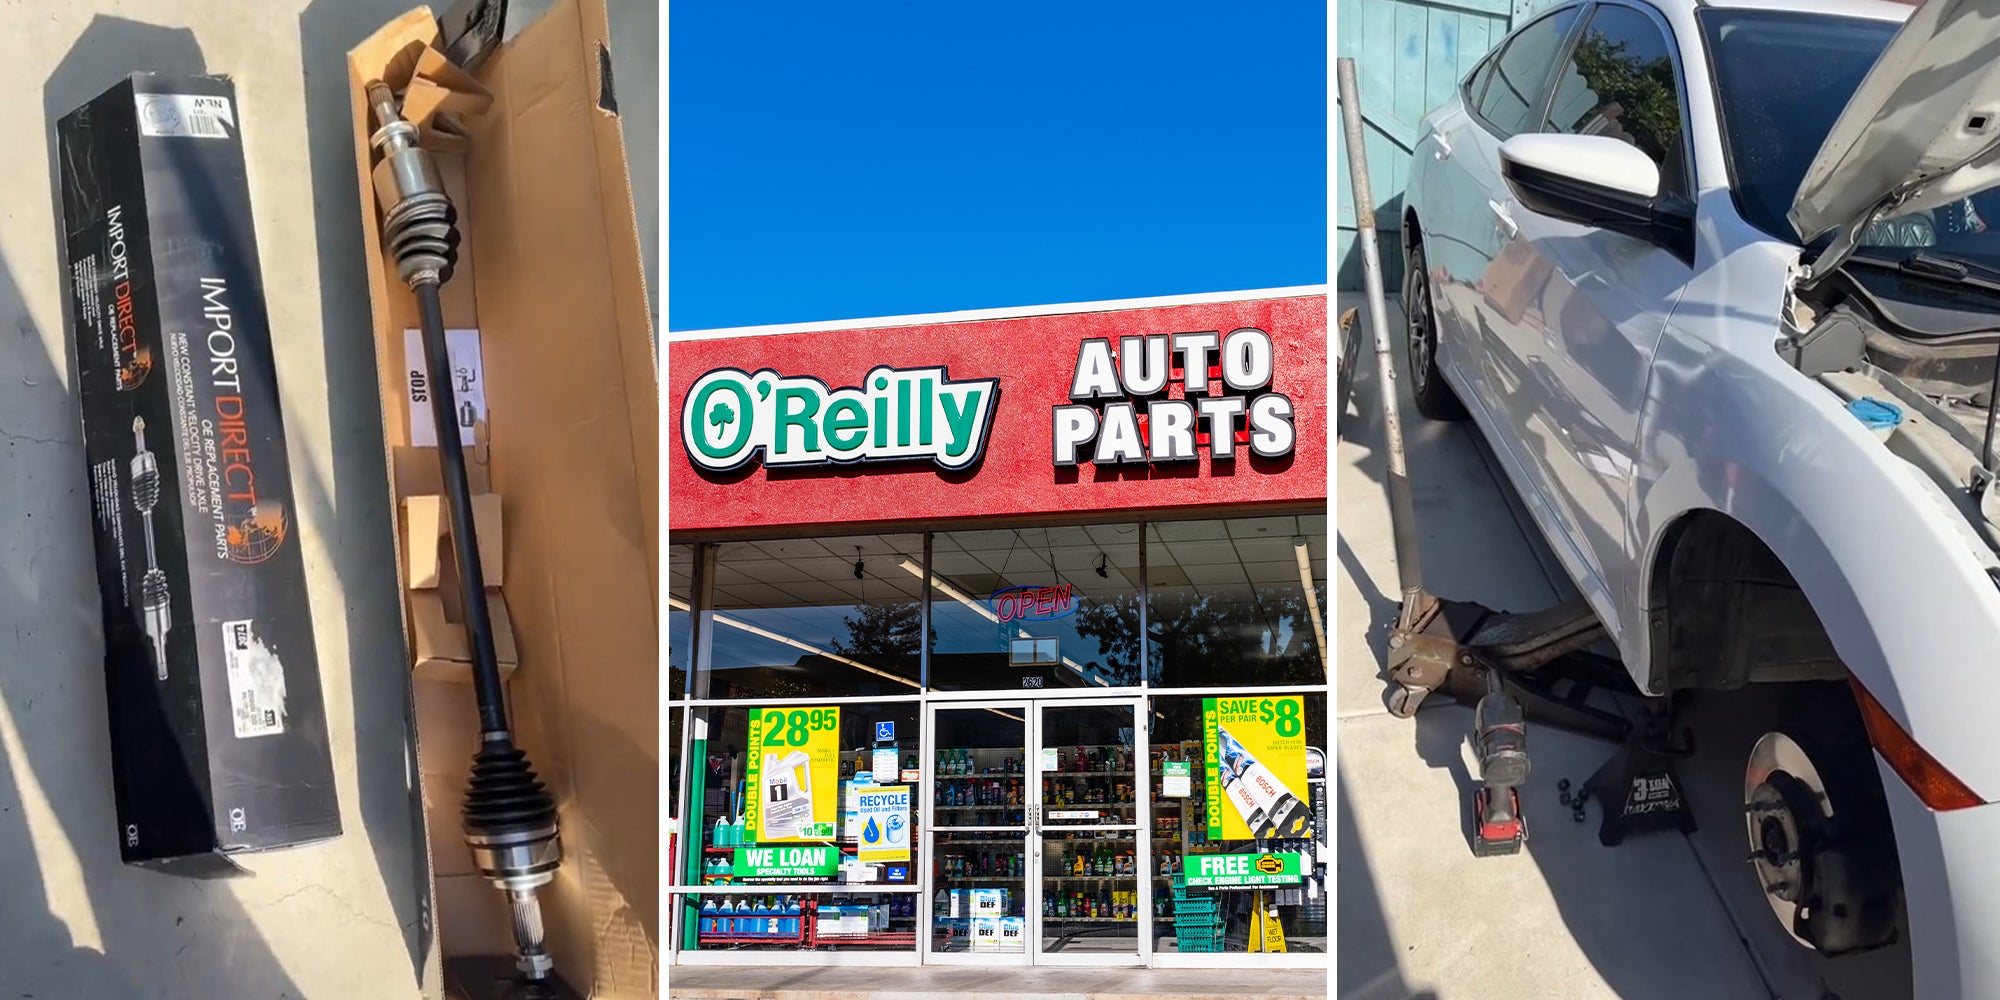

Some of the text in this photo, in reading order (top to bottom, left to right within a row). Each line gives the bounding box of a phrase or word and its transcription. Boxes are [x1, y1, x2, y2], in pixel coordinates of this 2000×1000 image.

[107, 204, 137, 354] IMPORT DIRECT
[108, 316, 120, 368] REPLACEMENT
[170, 333, 178, 356] NUEVO
[200, 277, 240, 392] IMPORT
[172, 356, 185, 394] VELOCIDAD
[1068, 328, 1274, 401] AUTO
[410, 370, 428, 402] STOP
[178, 396, 189, 436] CONSTANTE
[178, 332, 208, 513] NEW CONSTANT VELOCITY DRIVE AXLE
[691, 377, 982, 459] O'Reilly
[1052, 392, 1296, 466] PARTS
[215, 395, 258, 506] DIRECT
[202, 419, 230, 560] OE REPLACEMENT PARTS
[997, 584, 1072, 622] OPEN
[1022, 676, 1044, 688] 2620
[1220, 699, 1301, 738] SAVE $8
[746, 719, 760, 830] DOUBLE POINTS
[1206, 710, 1220, 828] DOUBLE POINTS
[1256, 776, 1276, 798] BOSCH
[860, 794, 907, 806] RECYCLE
[1238, 788, 1256, 808] BOSCH
[1634, 778, 1648, 801] 3
[798, 827, 812, 836] $10
[746, 848, 826, 866] WE LOAN
[1200, 856, 1249, 875] FREE
[1188, 877, 1212, 886] CHECK
[1215, 876, 1242, 884] ENGINE
[1268, 875, 1298, 883] TESTING
